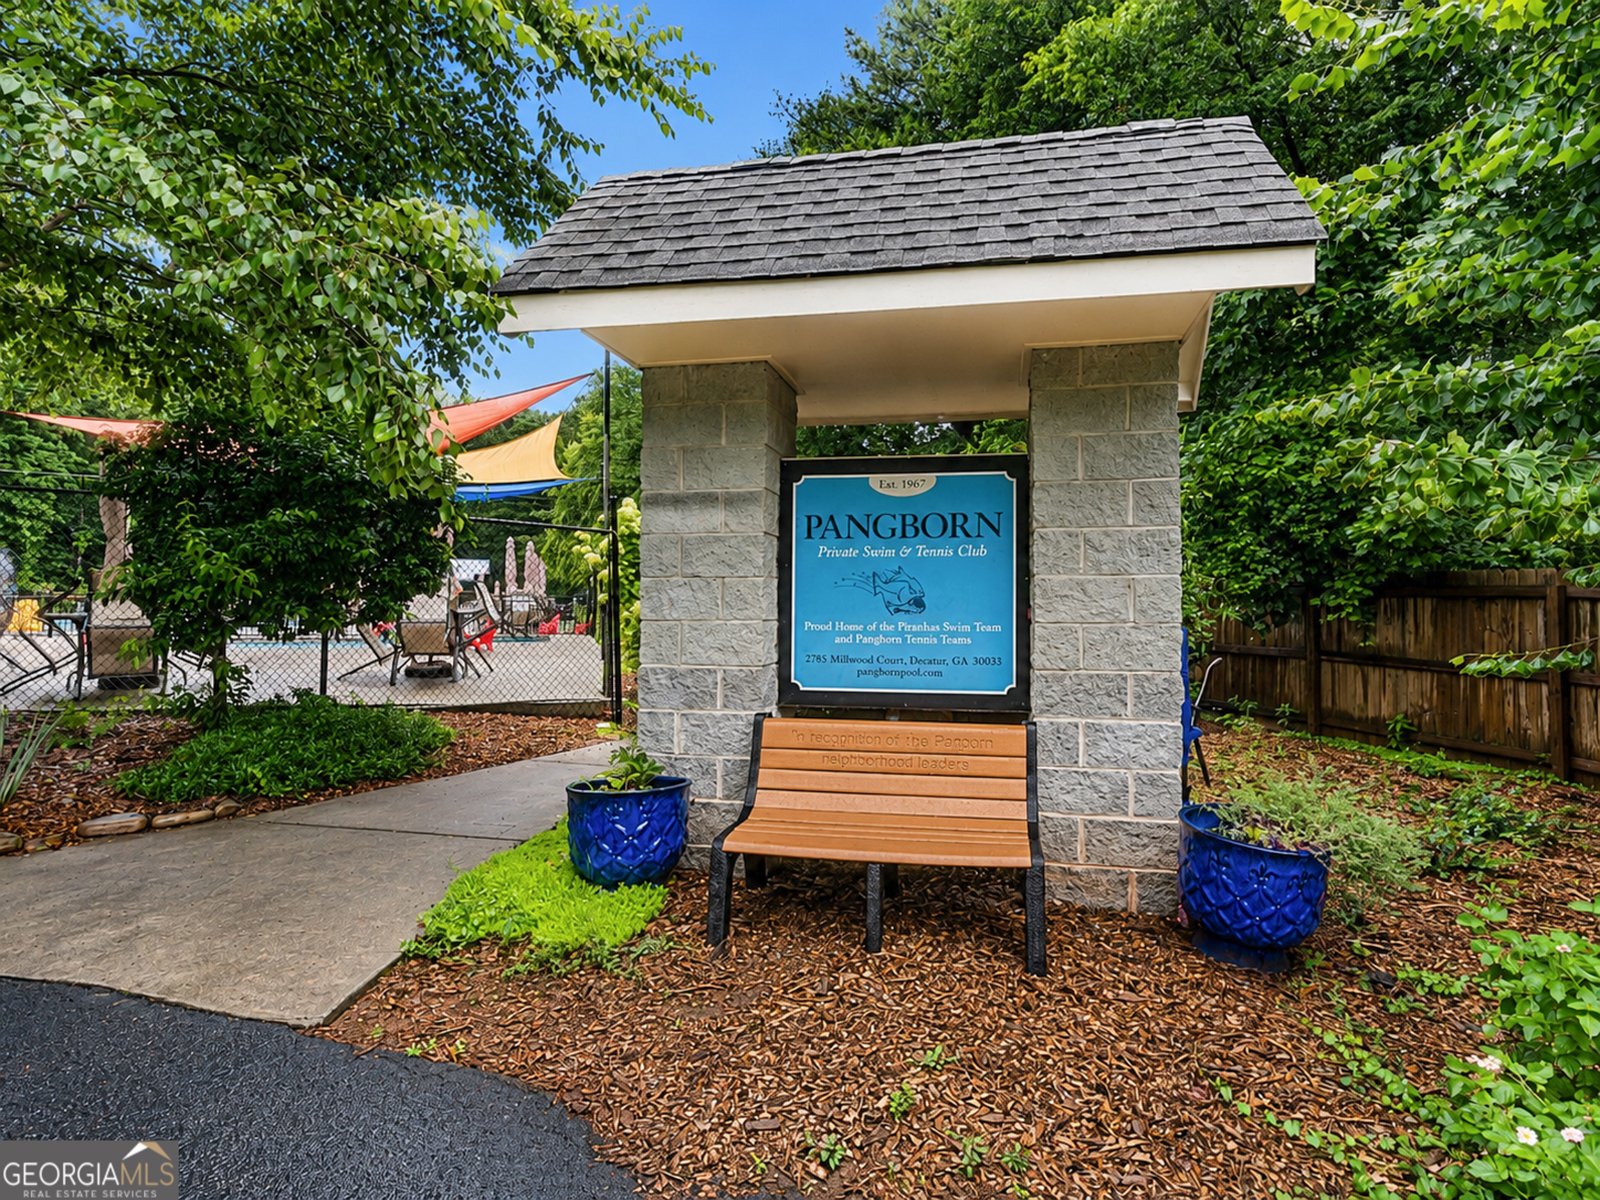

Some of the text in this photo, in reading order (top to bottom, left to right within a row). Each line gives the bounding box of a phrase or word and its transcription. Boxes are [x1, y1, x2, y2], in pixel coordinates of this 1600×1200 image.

[879, 479, 926, 488] Est. 1967
[804, 512, 1004, 540] PANGBORN
[818, 544, 987, 558] Private Swim & Tennis Club
[804, 622, 1002, 632] Proud Home of the Piranhas Swim Team
[834, 634, 852, 644] and
[904, 635, 938, 644] Tennis
[940, 636, 972, 645] Teams
[806, 655, 1002, 666] 2785 Millwood Court, Decatur, GA 30033
[856, 668, 943, 679] pangbornpool.com
[886, 733, 900, 745] of
[918, 756, 969, 771] leaders
